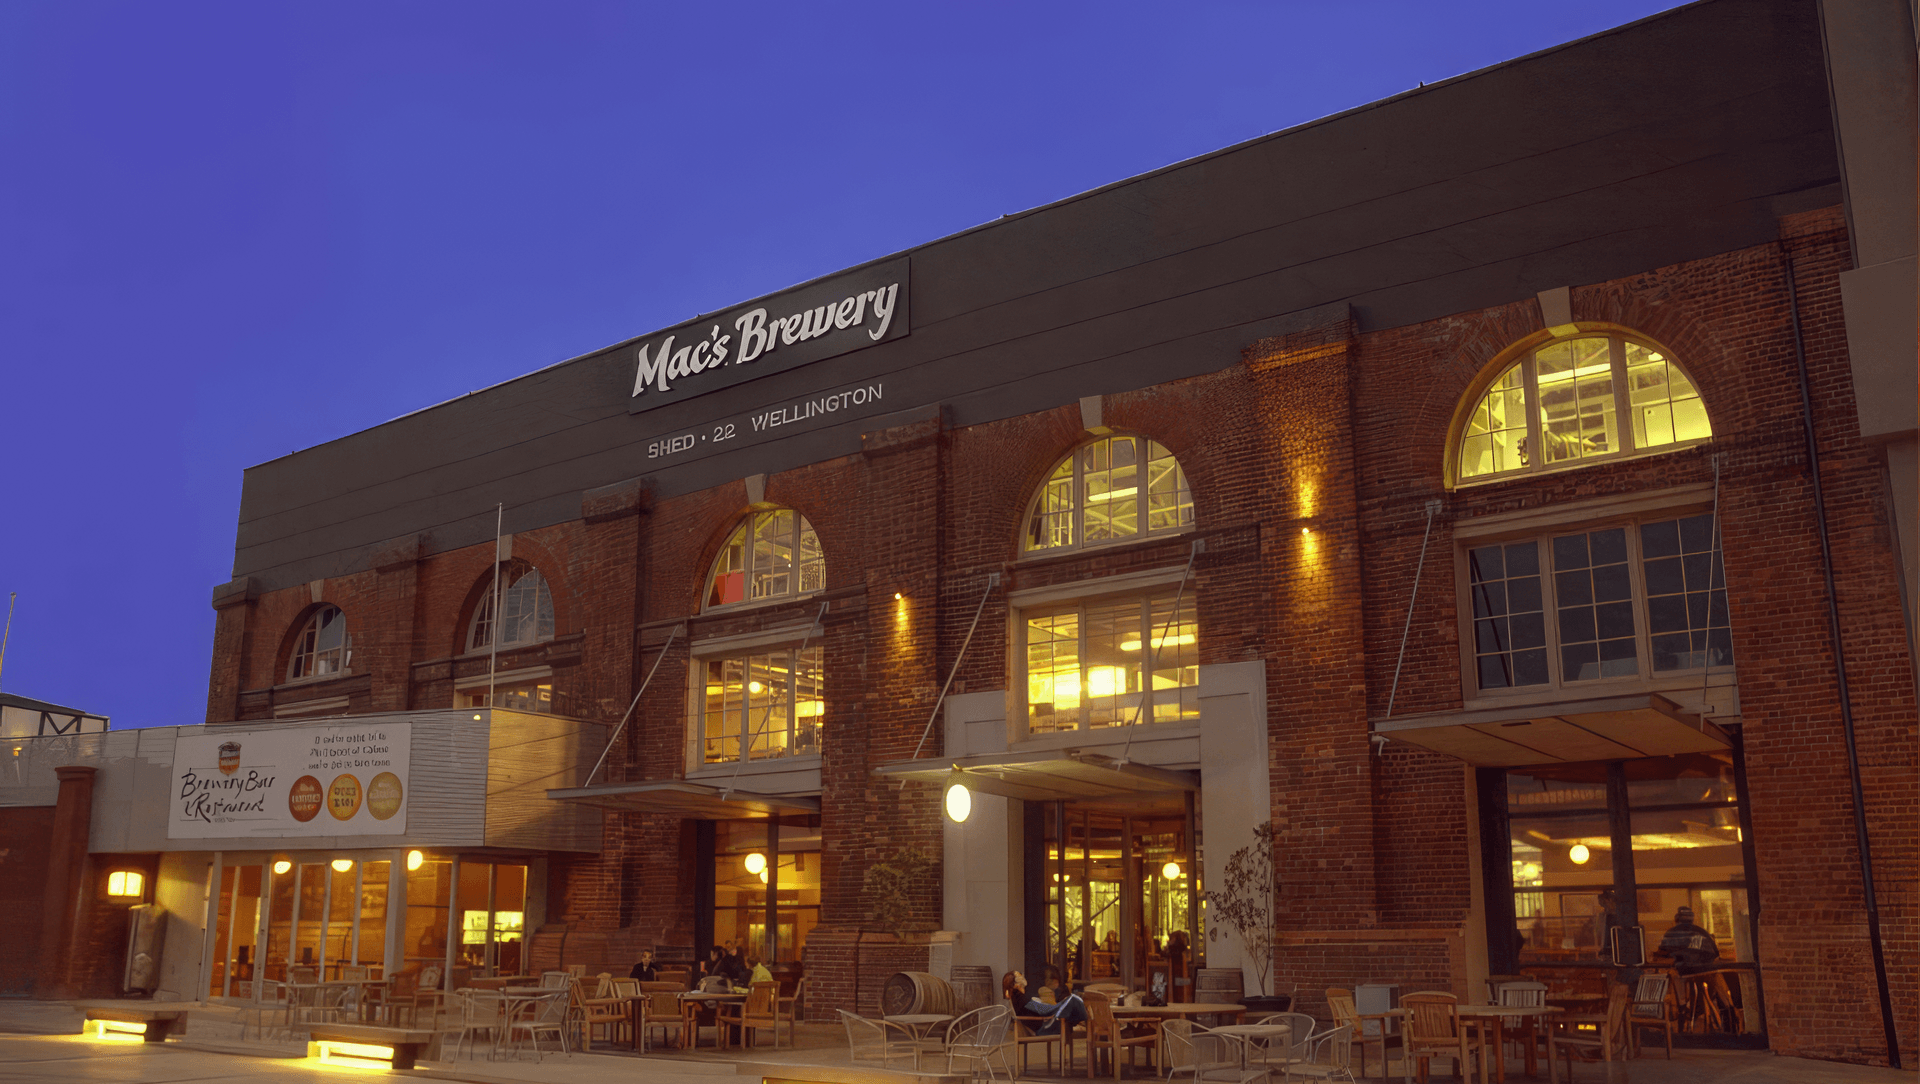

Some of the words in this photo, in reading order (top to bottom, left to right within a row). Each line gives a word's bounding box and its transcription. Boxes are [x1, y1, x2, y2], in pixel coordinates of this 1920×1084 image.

[631, 324, 732, 398] Mac's
[734, 282, 899, 365] Brewery
[647, 433, 695, 459] SHED
[712, 423, 736, 443] 22
[751, 383, 883, 432] WELLINGTON
